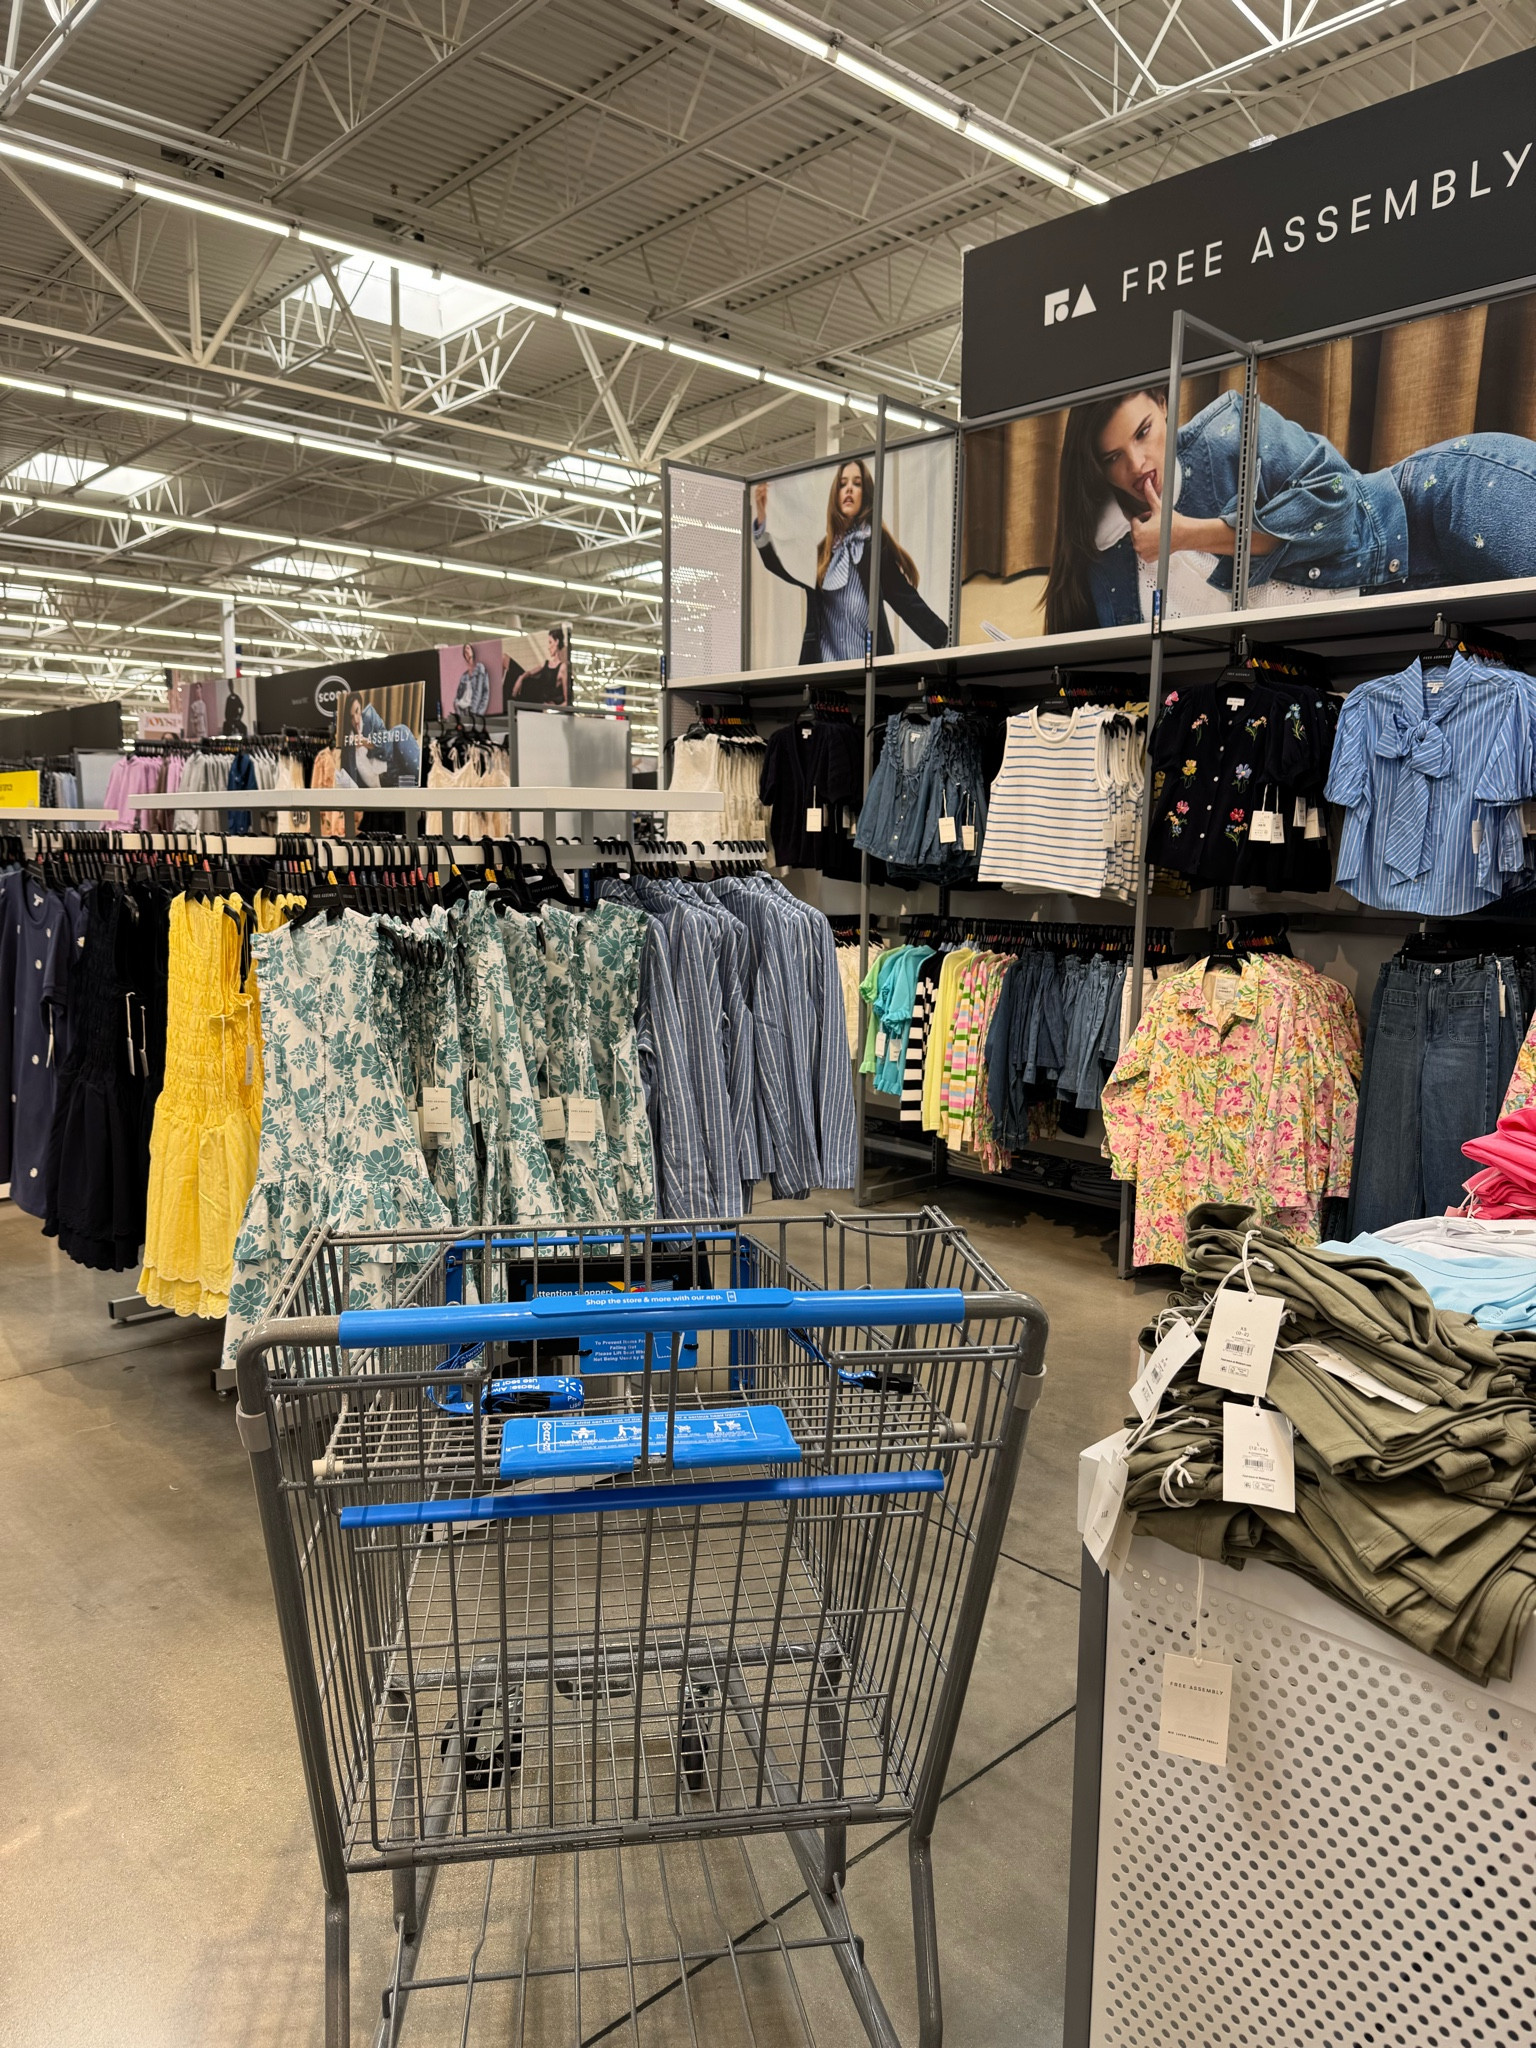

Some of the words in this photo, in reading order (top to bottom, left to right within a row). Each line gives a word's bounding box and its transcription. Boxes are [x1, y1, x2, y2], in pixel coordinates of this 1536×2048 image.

[1122, 240, 1224, 303] FREE
[1250, 142, 1533, 264] ASSEMBLY
[344, 733, 364, 747] FREE
[367, 730, 410, 745] ASSEMBLY
[586, 1298, 607, 1306] Shop
[608, 1297, 621, 1305] the
[672, 1294, 690, 1302] with
[706, 1294, 723, 1302] app.
[1169, 1681, 1187, 1689] FREE
[1189, 1685, 1224, 1696] ASSEMBLY
